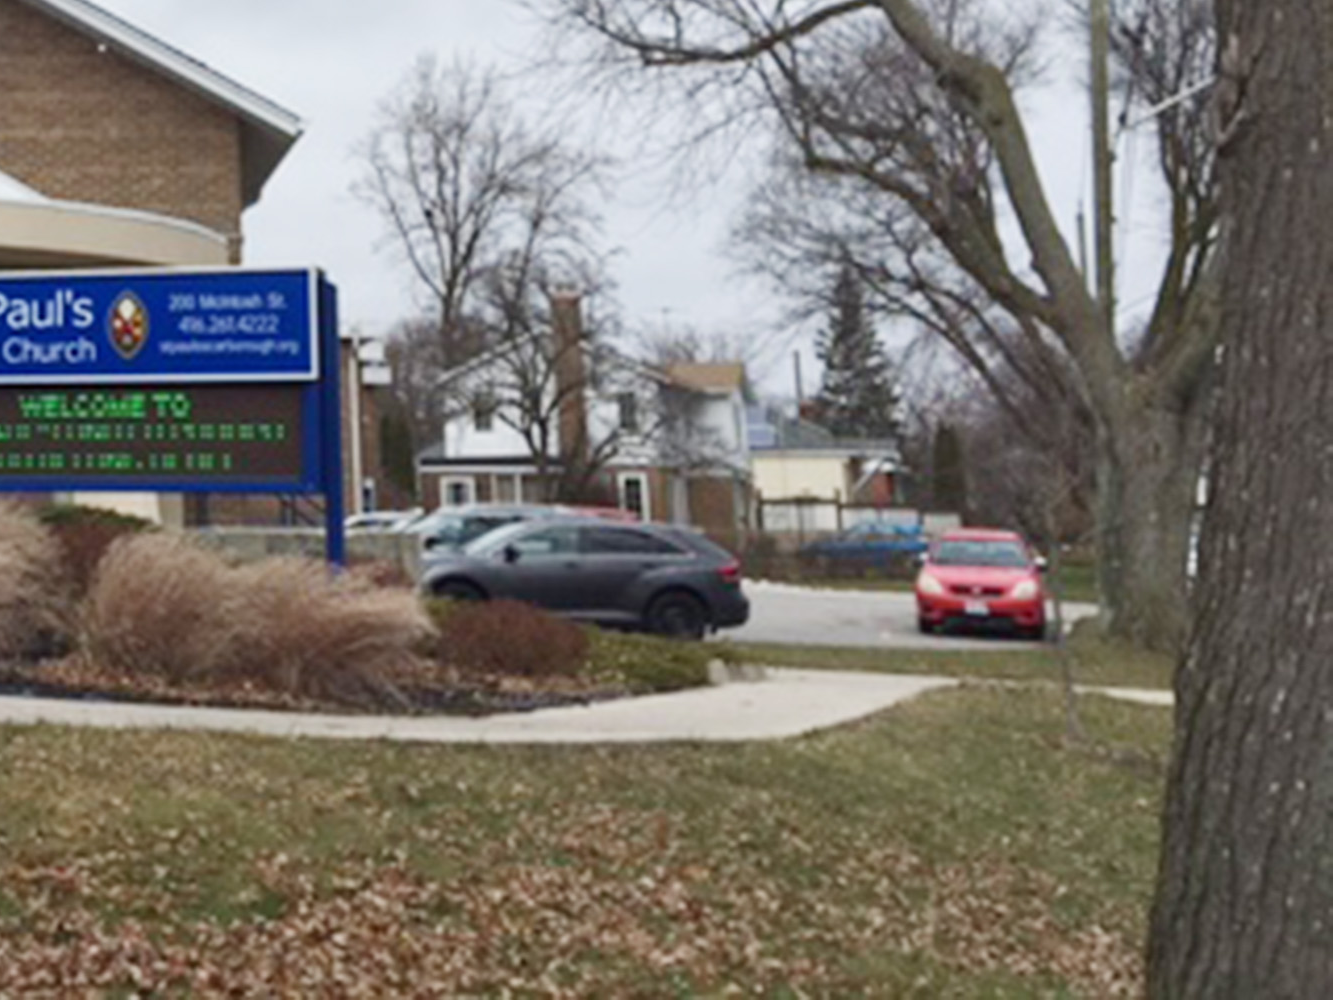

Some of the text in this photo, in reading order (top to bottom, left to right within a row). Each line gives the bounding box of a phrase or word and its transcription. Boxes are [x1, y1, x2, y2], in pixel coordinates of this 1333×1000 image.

[3, 337, 96, 364] Church
[19, 394, 190, 417] WELCOME TO
